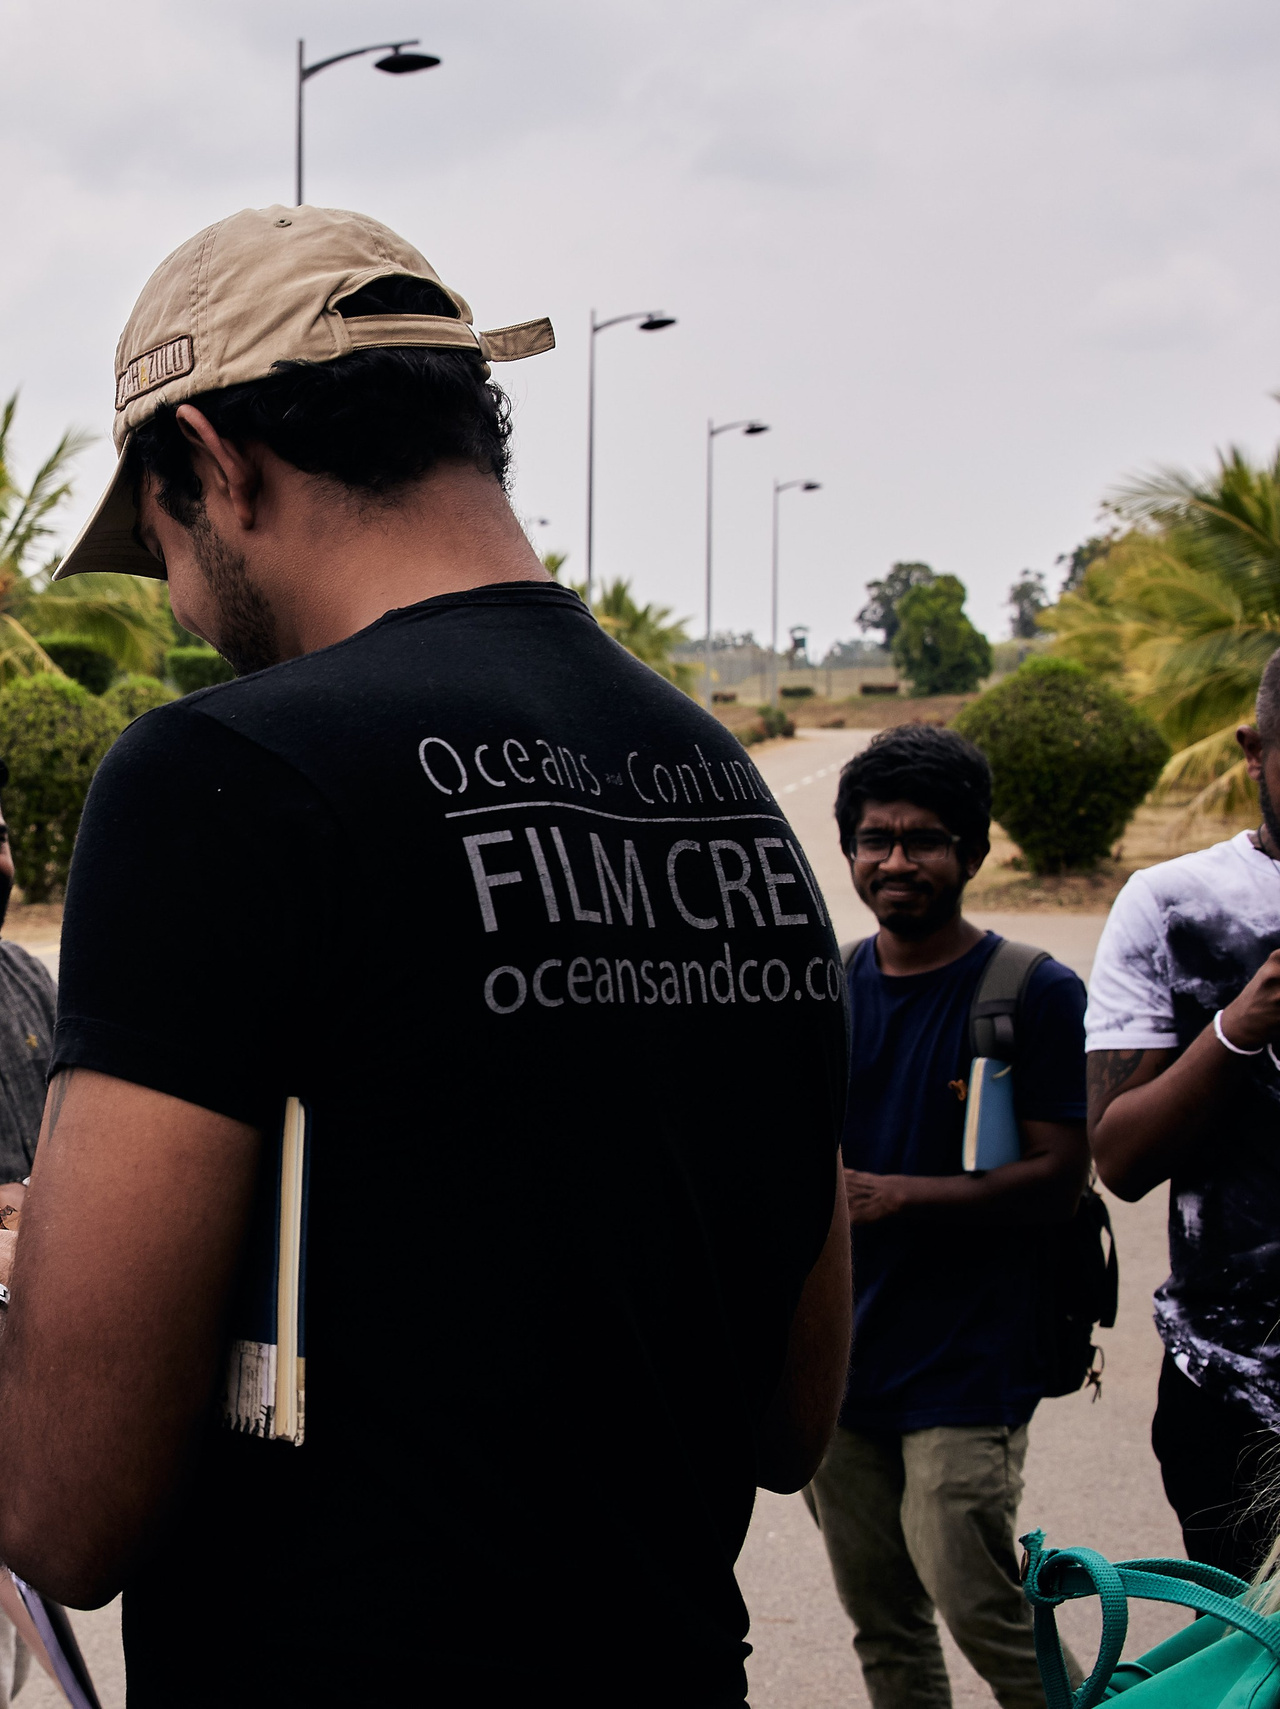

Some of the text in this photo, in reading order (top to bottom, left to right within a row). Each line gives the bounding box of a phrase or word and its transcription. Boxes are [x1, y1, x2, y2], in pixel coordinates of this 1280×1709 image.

[148, 340, 184, 384] ZULU
[419, 737, 601, 796] Oceans
[462, 826, 656, 933] FILM
[483, 941, 849, 1015] oceansandco.co
